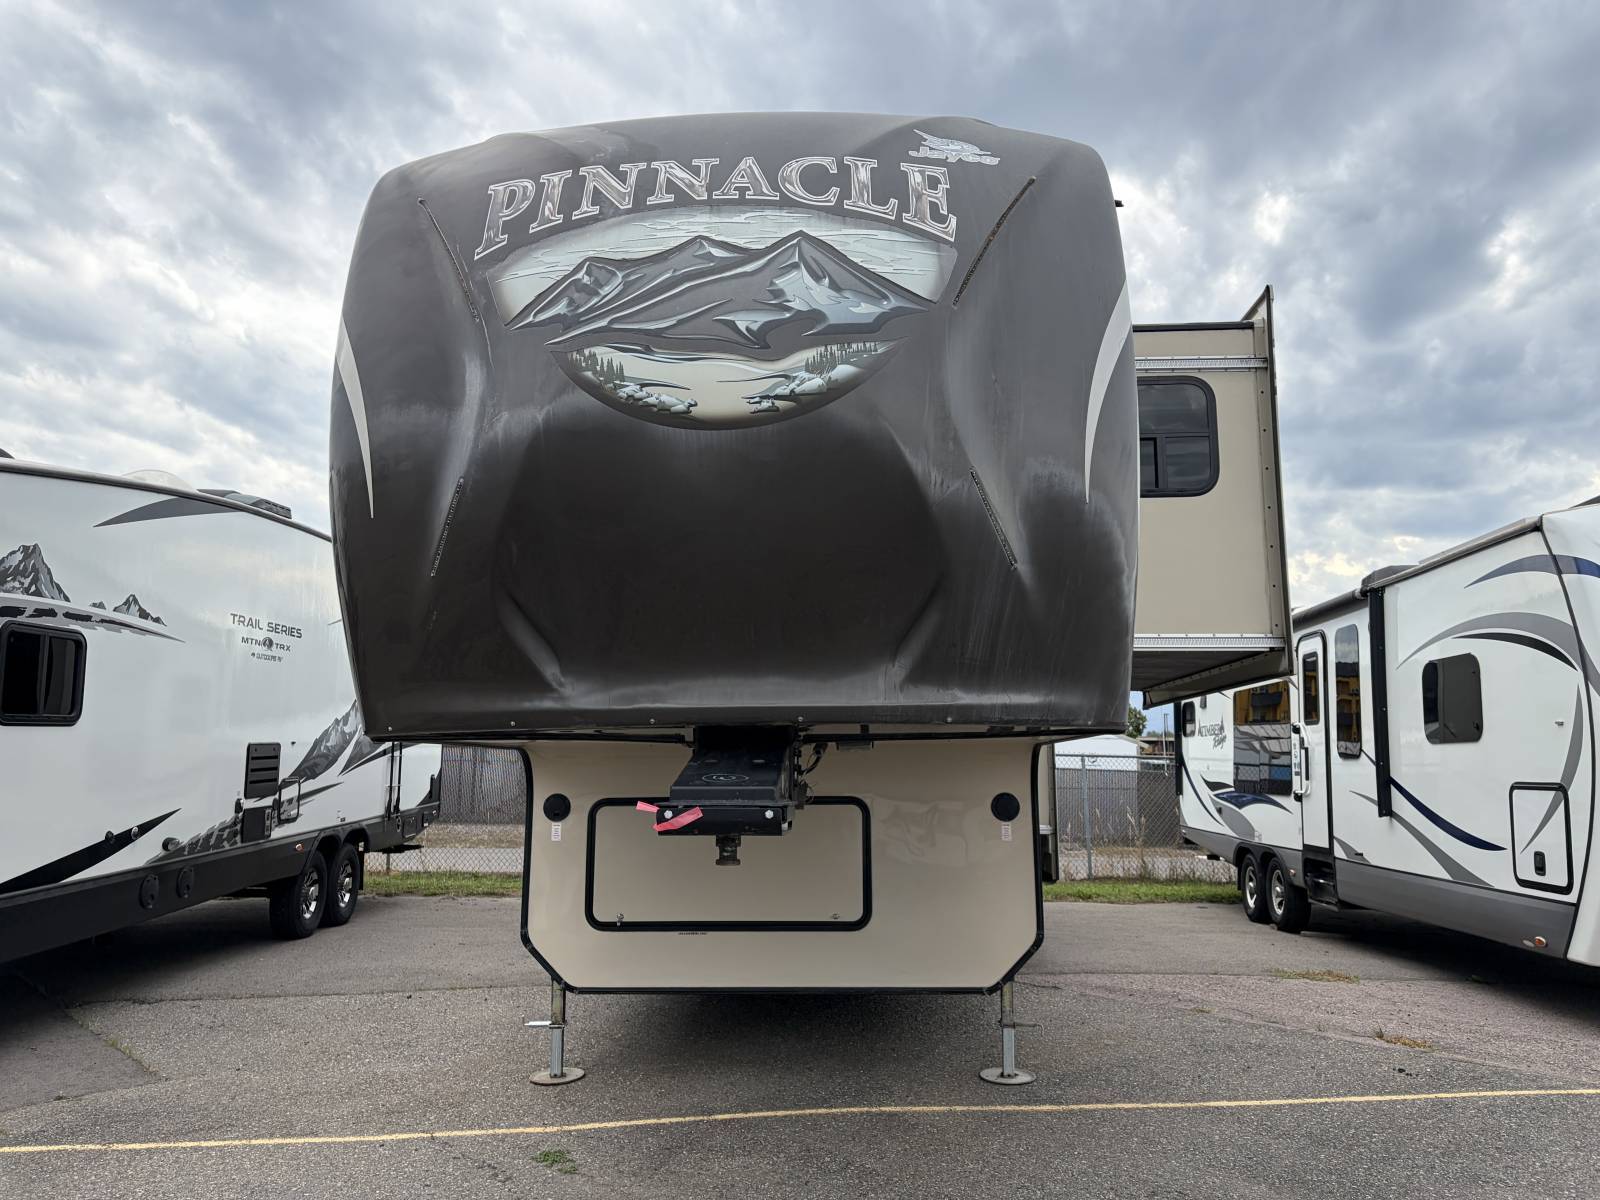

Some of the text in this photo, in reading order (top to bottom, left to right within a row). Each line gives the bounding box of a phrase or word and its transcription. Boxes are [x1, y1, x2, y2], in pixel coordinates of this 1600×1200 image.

[474, 156, 957, 260] PINNACLE
[230, 613, 303, 639] TRAIL SERIES
[241, 636, 291, 652] MTN TRX
